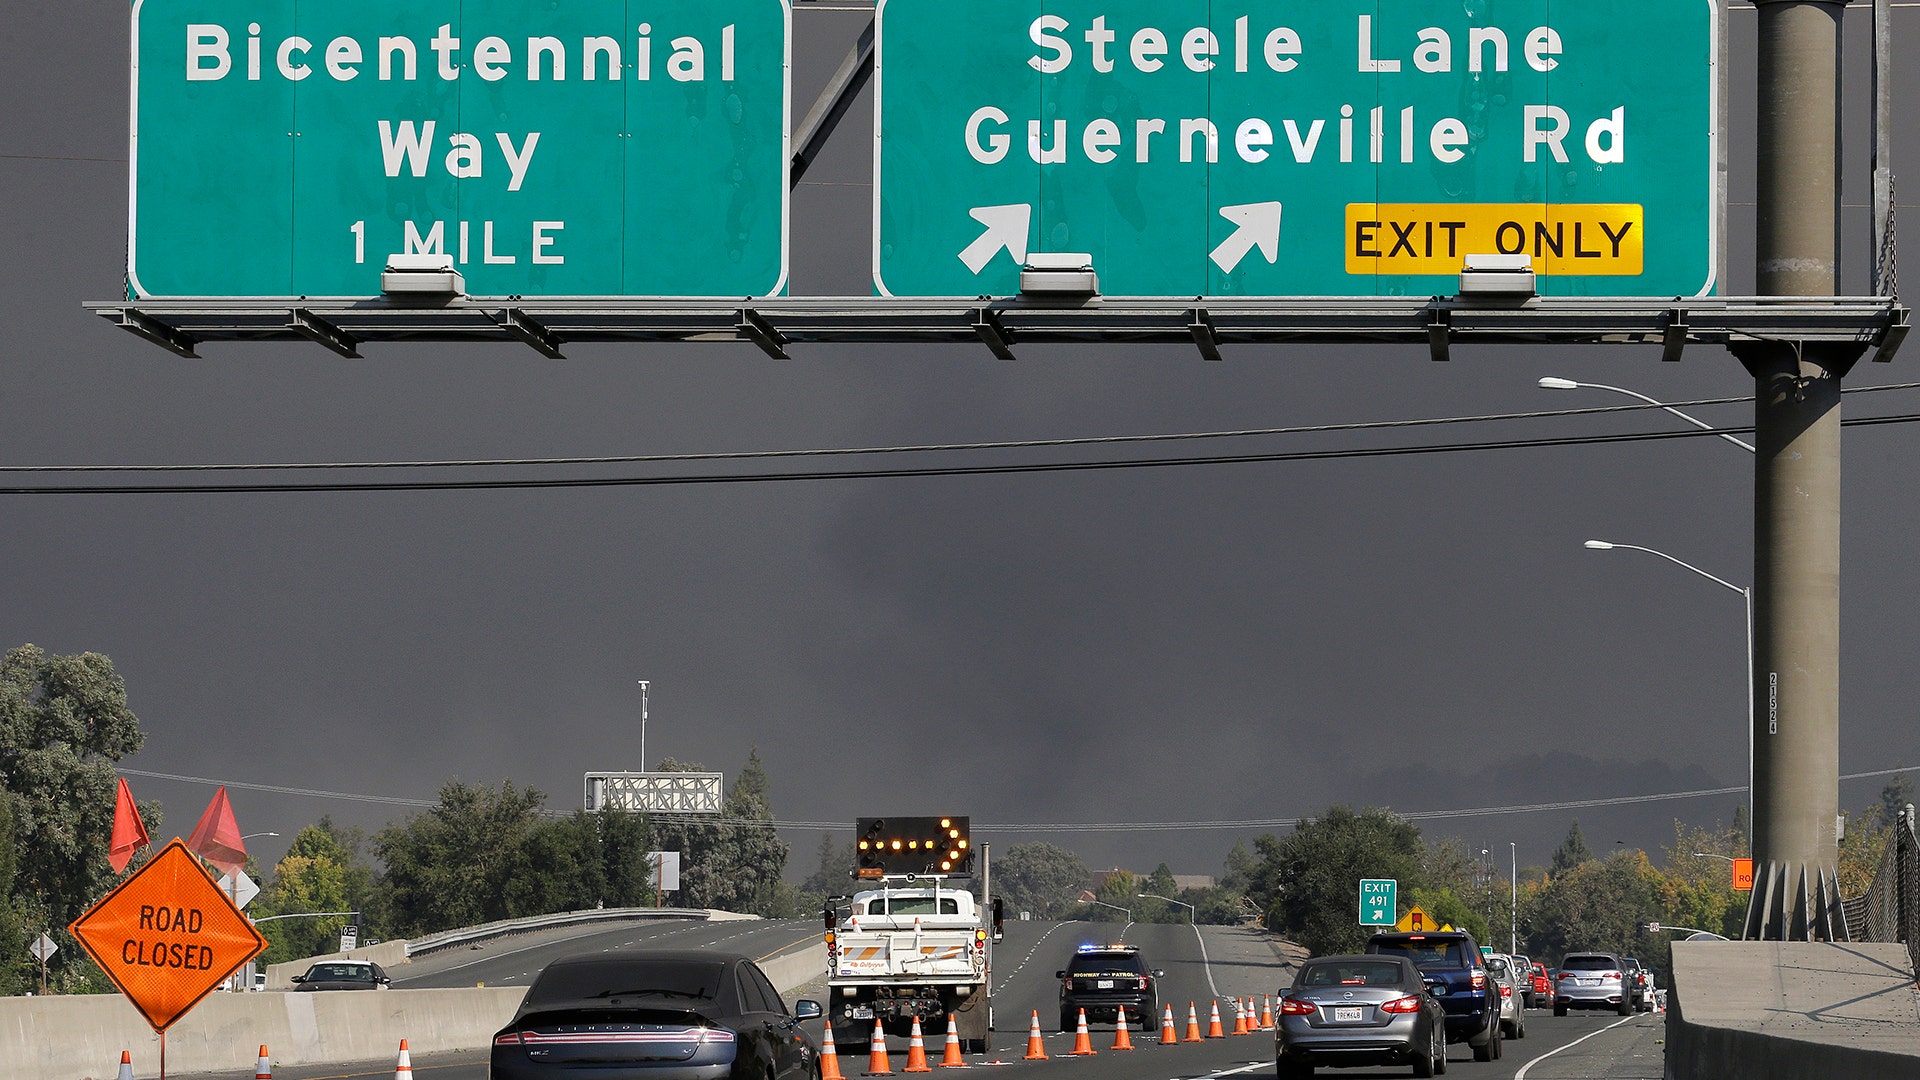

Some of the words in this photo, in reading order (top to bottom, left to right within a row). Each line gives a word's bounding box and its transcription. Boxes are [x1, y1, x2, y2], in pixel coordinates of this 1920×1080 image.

[186, 22, 735, 82] Bicentennial
[1027, 14, 1302, 74] Steele
[1358, 14, 1563, 73] Lane
[964, 104, 1469, 165] Guerneville
[1523, 104, 1625, 165] Rd
[377, 120, 541, 192] Way
[350, 220, 365, 264] 1
[404, 220, 565, 265] MILE
[1355, 221, 1466, 258] EXIT
[1495, 221, 1633, 258] ONLY
[1364, 883, 1392, 893] EXIT
[1368, 895, 1387, 907] 491
[139, 904, 203, 934] ROAD
[122, 939, 213, 971] CLOSED
